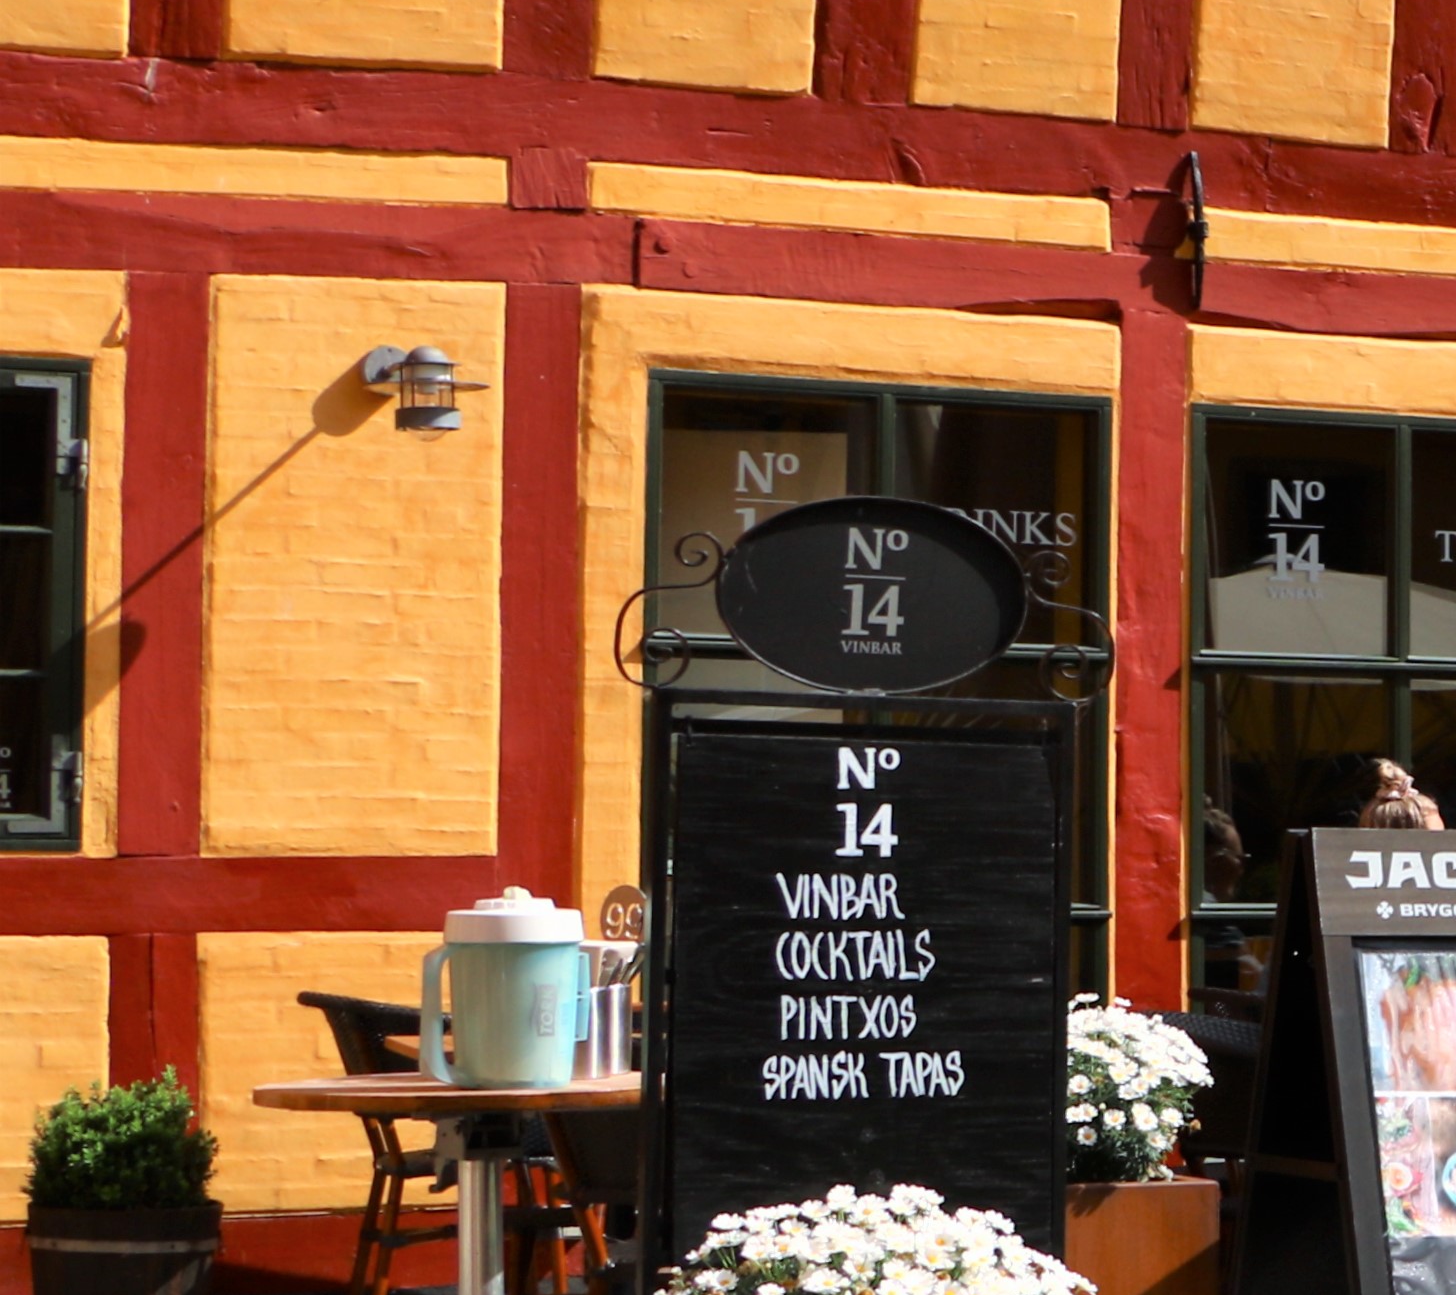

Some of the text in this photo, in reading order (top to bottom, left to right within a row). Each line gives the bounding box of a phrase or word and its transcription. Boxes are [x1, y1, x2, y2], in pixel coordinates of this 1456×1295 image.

[1267, 532, 1325, 584] 14
[840, 583, 905, 637] 14
[839, 639, 903, 655] VINBAR
[835, 802, 899, 858] 14
[775, 872, 906, 921] VINBAR
[775, 928, 936, 982] COCKTAILS
[780, 994, 917, 1041] PINTXOS
[762, 1050, 965, 1101] SPANSK TAPAS
